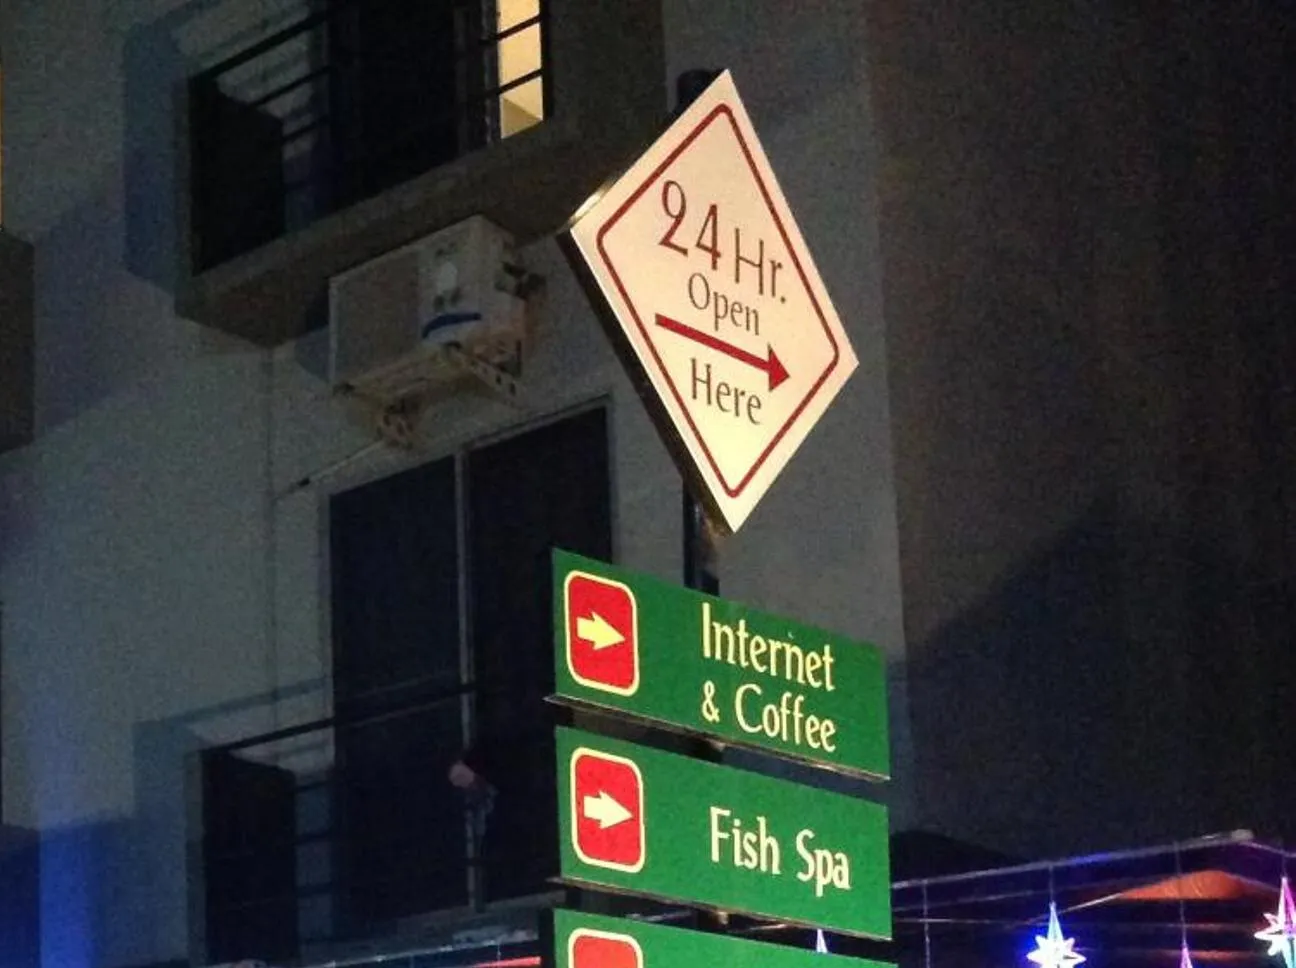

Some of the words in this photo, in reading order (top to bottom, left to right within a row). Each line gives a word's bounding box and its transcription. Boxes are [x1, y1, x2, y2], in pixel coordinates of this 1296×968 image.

[658, 179, 722, 271] 24
[733, 226, 786, 305] Hr.
[687, 272, 760, 336] Open
[690, 357, 762, 426] Here
[702, 602, 835, 692] Internet
[701, 680, 720, 723] &
[735, 683, 836, 753] Coffee
[709, 806, 781, 876] Fish
[795, 828, 852, 898] Spa
